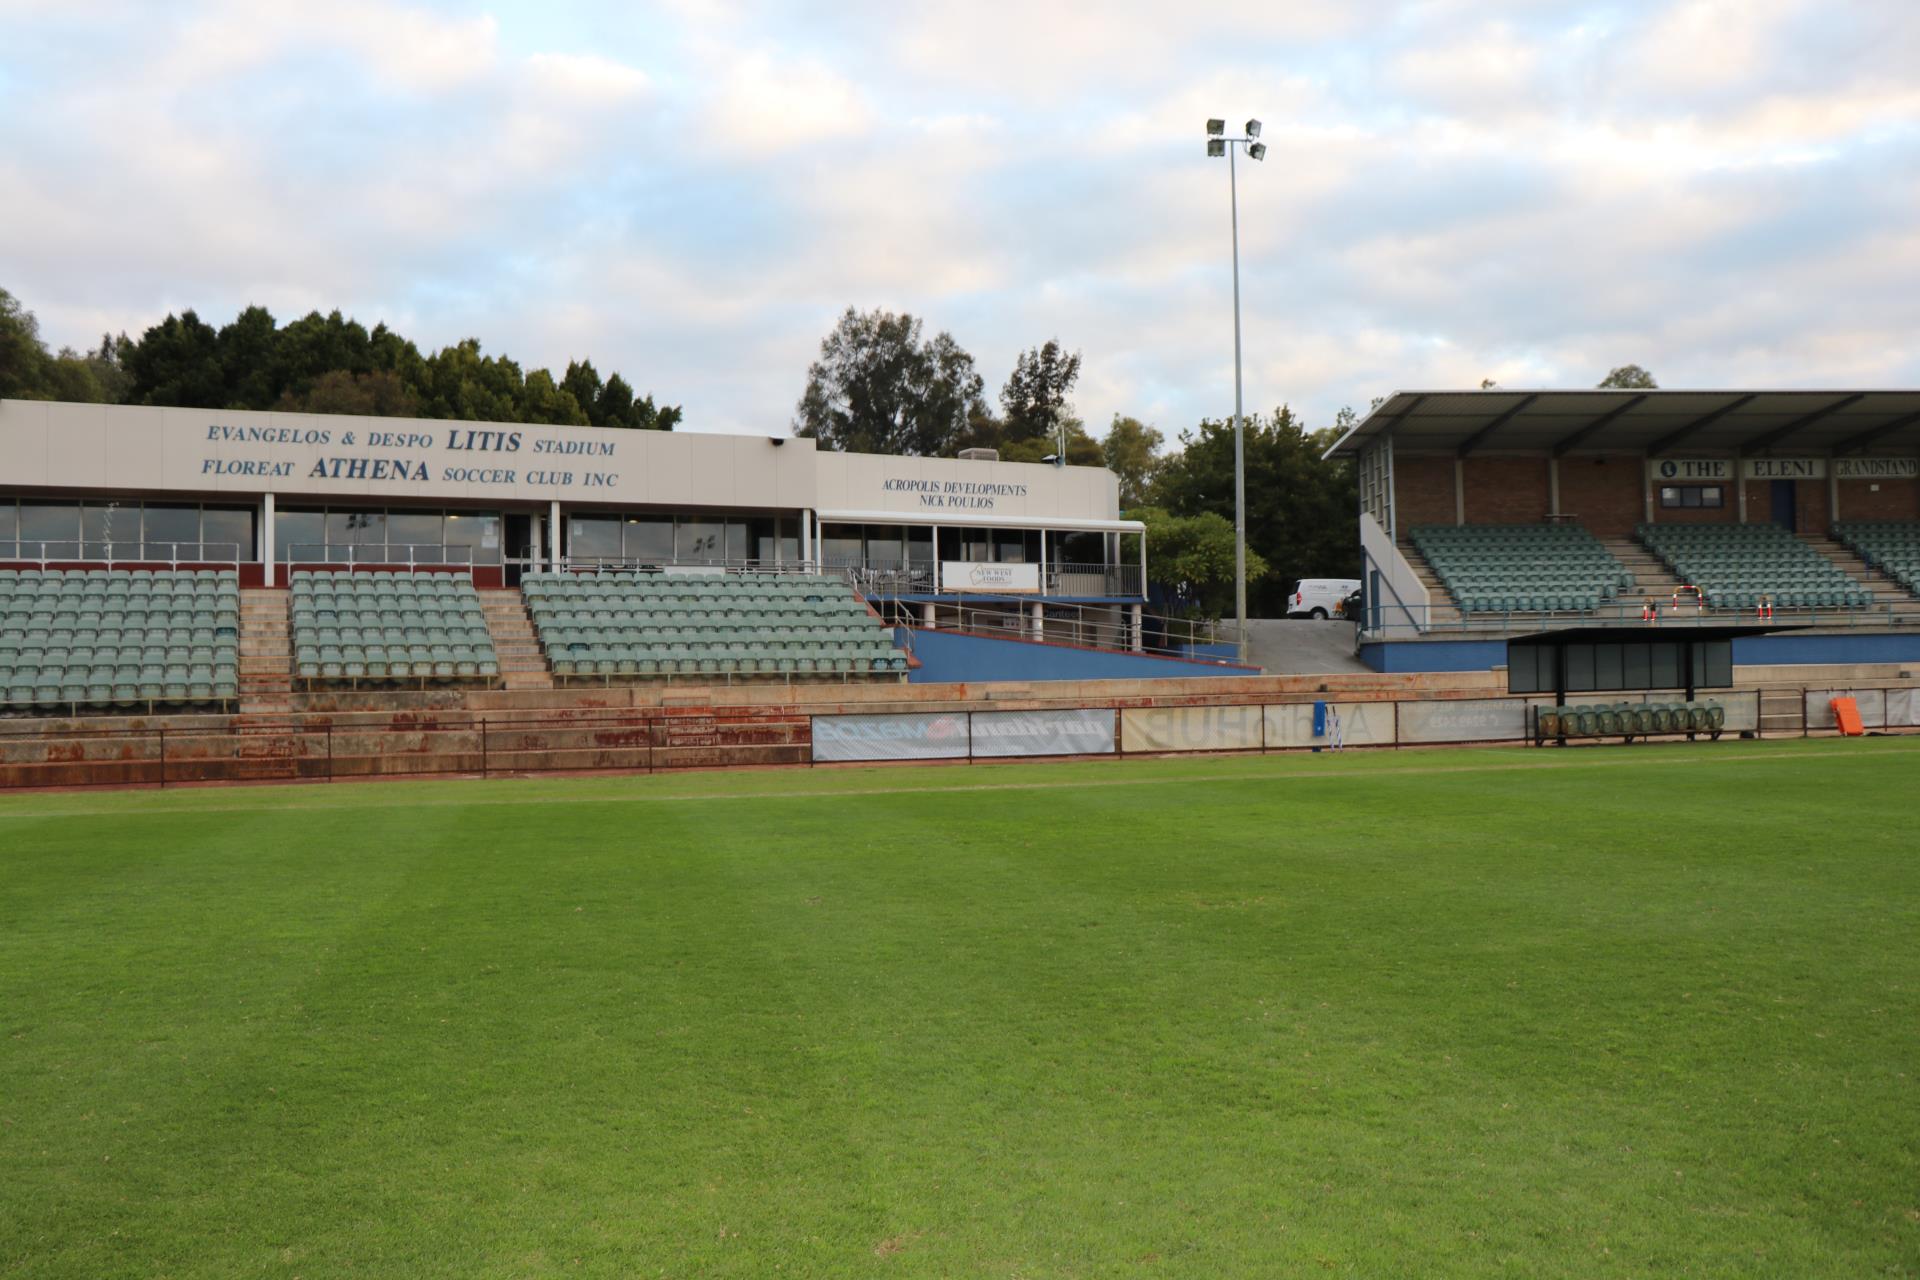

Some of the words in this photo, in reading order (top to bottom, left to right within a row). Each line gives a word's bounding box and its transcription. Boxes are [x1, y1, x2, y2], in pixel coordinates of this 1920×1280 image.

[206, 424, 331, 445] EVANGELOS
[341, 431, 356, 447] &
[367, 431, 433, 449] DESPO
[446, 429, 522, 452] LITIS
[533, 438, 616, 457] STADIUM
[201, 459, 295, 477] FLOREAT
[308, 456, 430, 481] ATHENA
[442, 466, 516, 484] SOCCER
[526, 469, 574, 486] CLUB
[583, 470, 619, 487] INC
[1681, 461, 1726, 478] THE
[1754, 460, 1817, 477] ELENI
[1836, 459, 1918, 476] GRANDSTAND
[882, 479, 941, 493] ACROPOLIS
[944, 481, 1028, 497] DEVELOPMENTS
[919, 495, 946, 507] NICK
[948, 496, 995, 509] POULIOS
